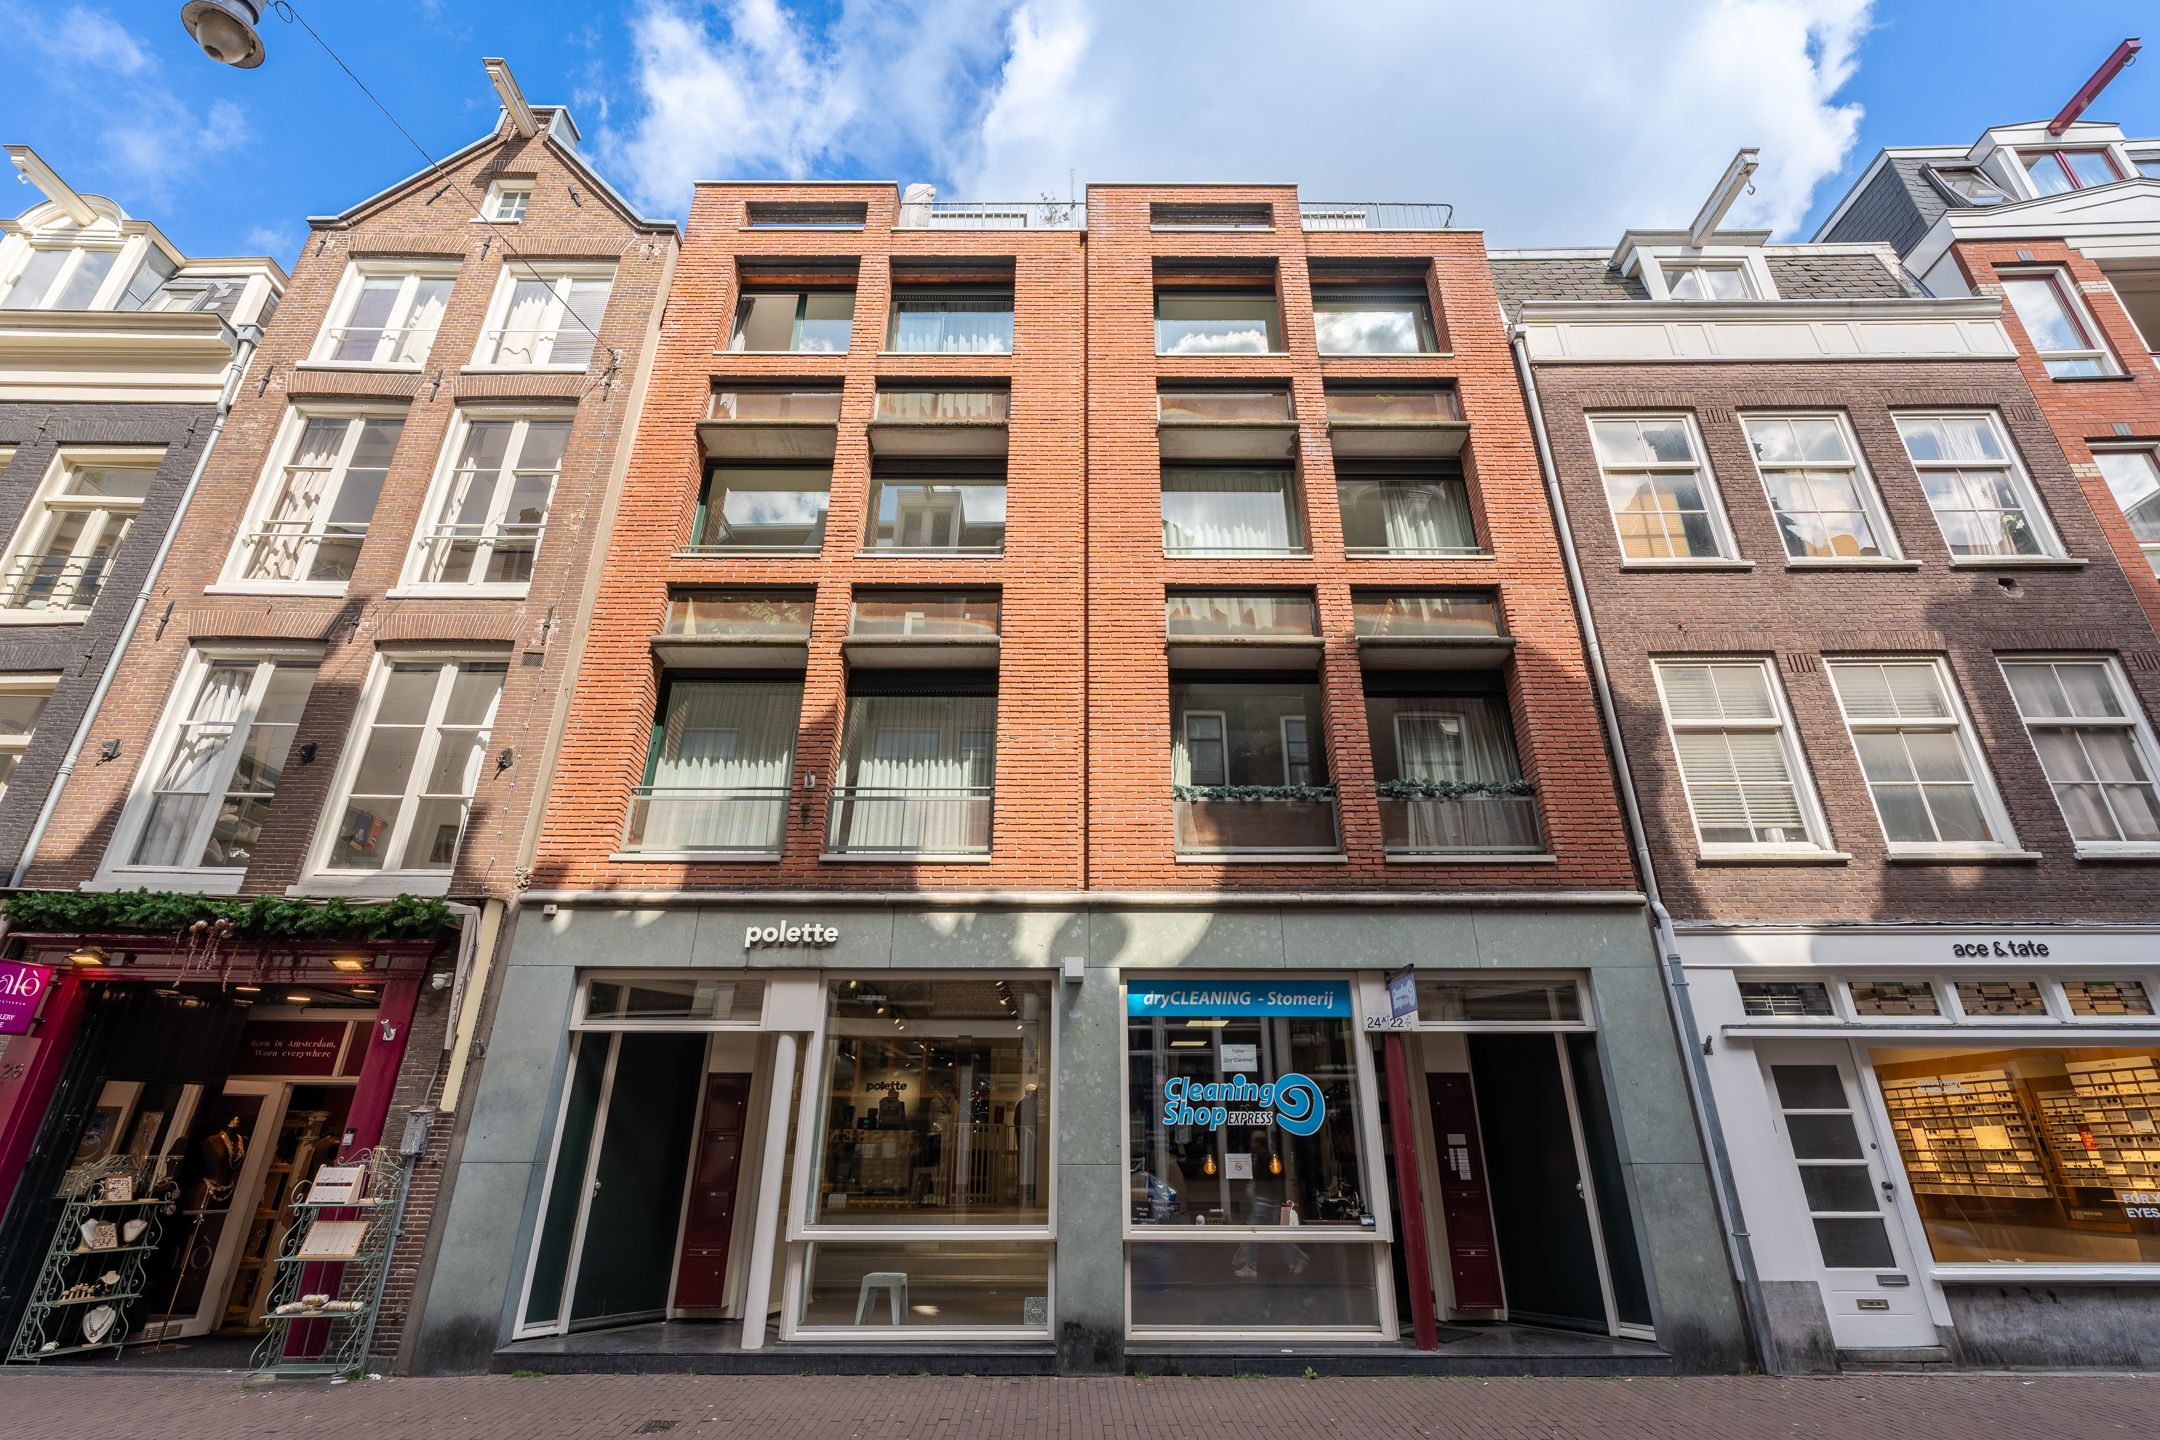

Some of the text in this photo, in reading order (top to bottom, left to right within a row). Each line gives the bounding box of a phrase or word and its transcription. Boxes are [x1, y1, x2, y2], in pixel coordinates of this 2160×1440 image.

[745, 920, 839, 948] polette
[1953, 940, 2050, 957] ace & tate
[1143, 991, 1251, 1009] dryCLEANING
[1267, 991, 1334, 1009] Stomerij
[288, 1038, 336, 1048] Amsterdam,
[282, 1048, 332, 1058] everywhere
[866, 1081, 907, 1092] polette
[1164, 1073, 1276, 1108] Cleaning
[1163, 1100, 1274, 1132] Shop EXPRESS
[2122, 1193, 2150, 1204] FOR
